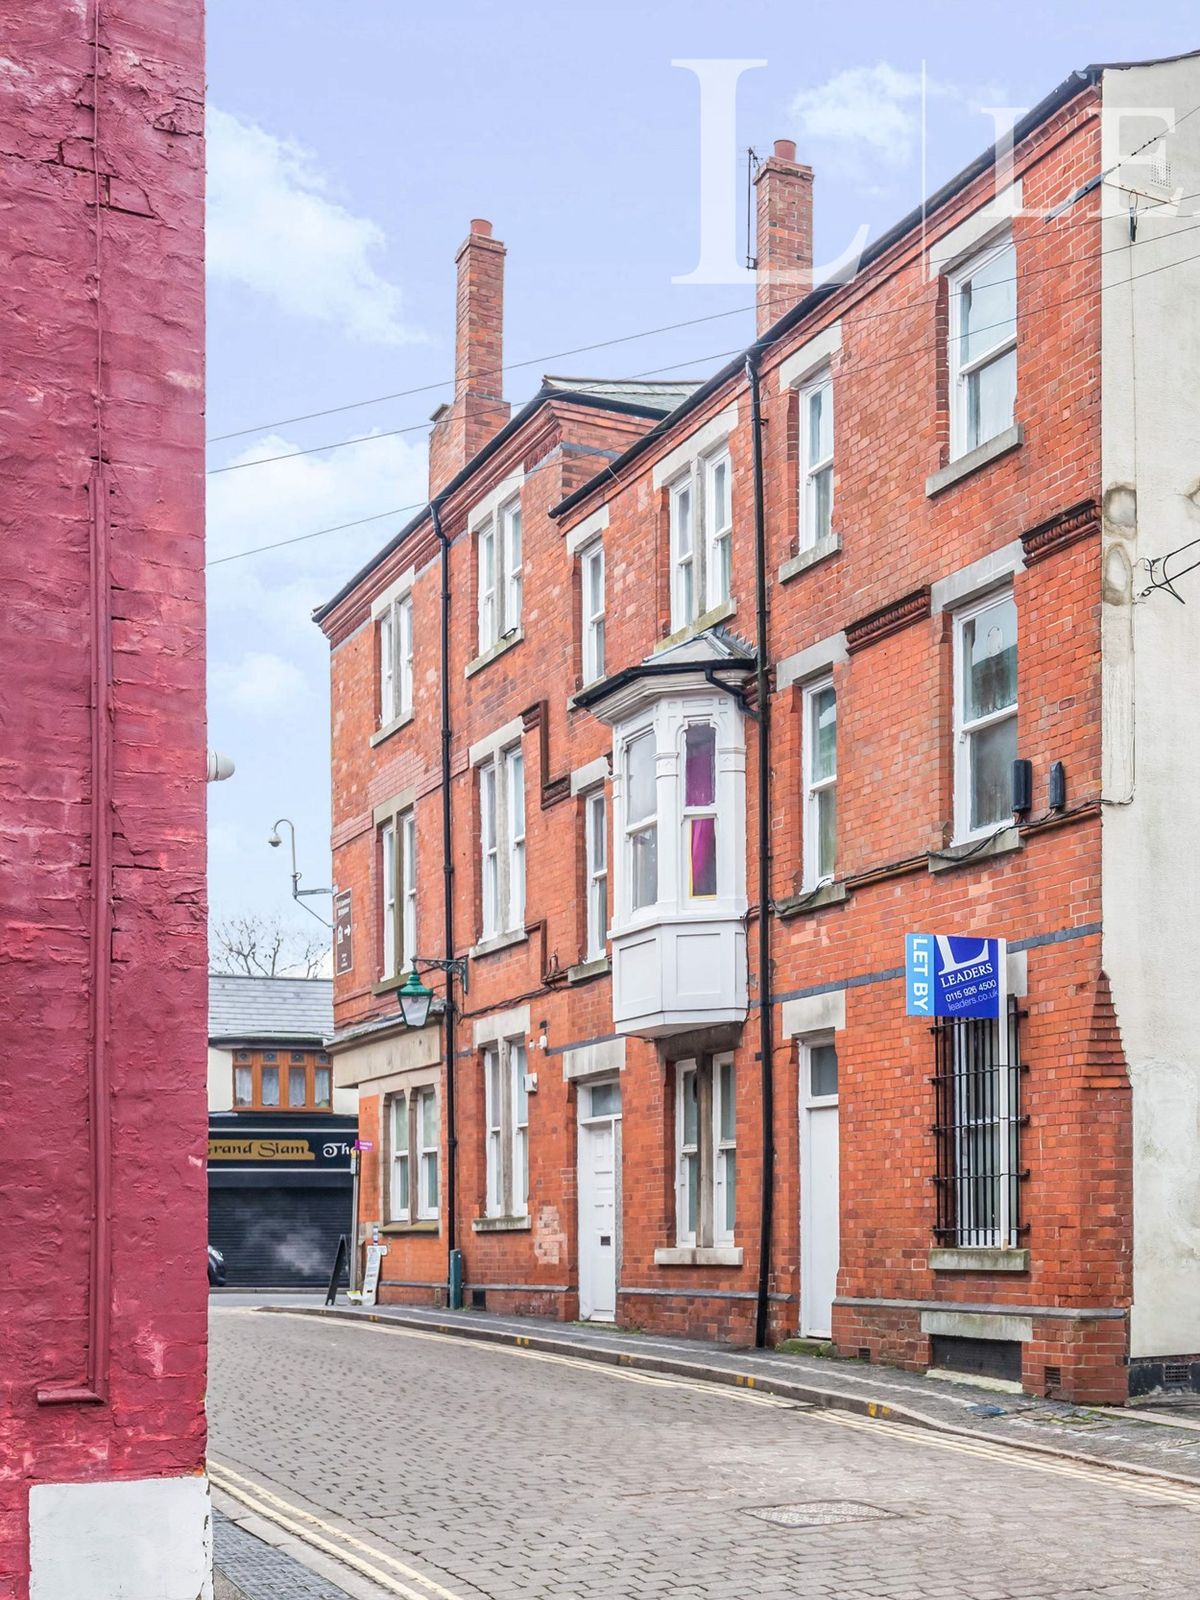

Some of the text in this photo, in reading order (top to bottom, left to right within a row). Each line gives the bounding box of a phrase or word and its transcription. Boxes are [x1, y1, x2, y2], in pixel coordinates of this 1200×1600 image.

[913, 938, 928, 1011] LET BY
[941, 963, 993, 988] LEADERS
[945, 979, 997, 1002] 0115 926 4500
